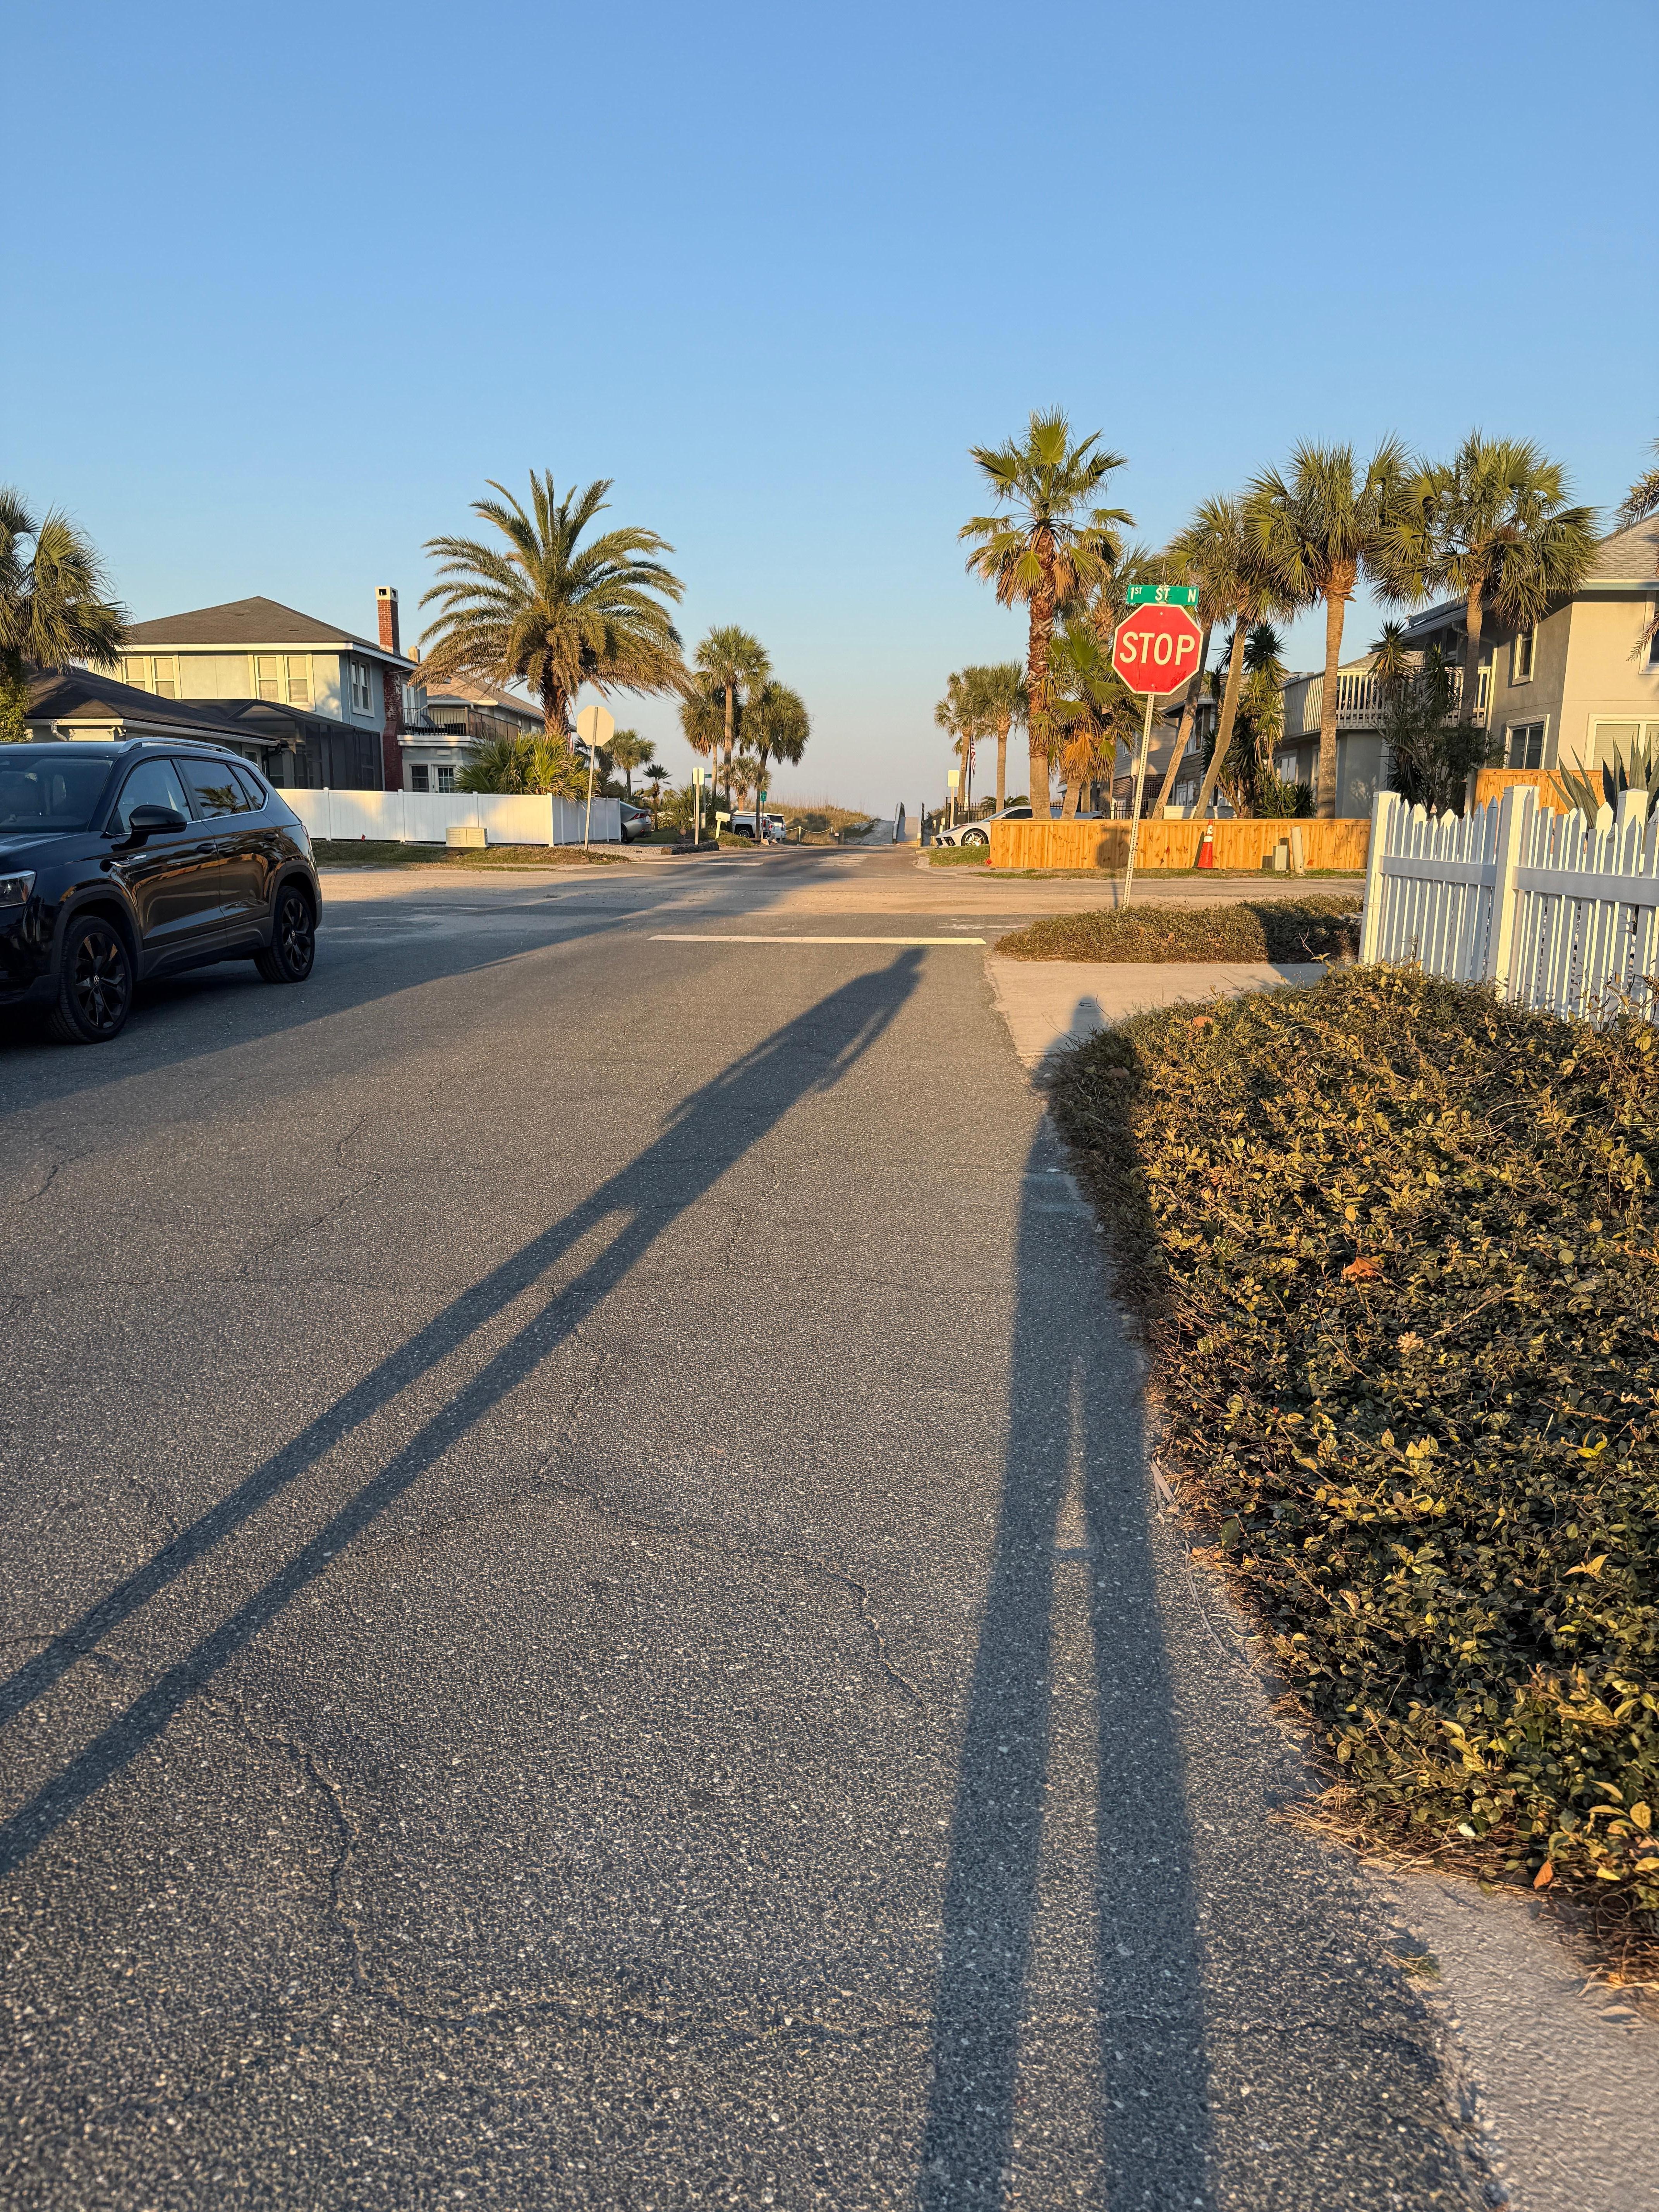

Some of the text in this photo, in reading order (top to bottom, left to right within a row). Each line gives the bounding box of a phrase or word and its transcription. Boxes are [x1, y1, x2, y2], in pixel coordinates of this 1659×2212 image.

[1130, 587, 1196, 602] 1ST ST N
[1119, 631, 1195, 666] STOP
